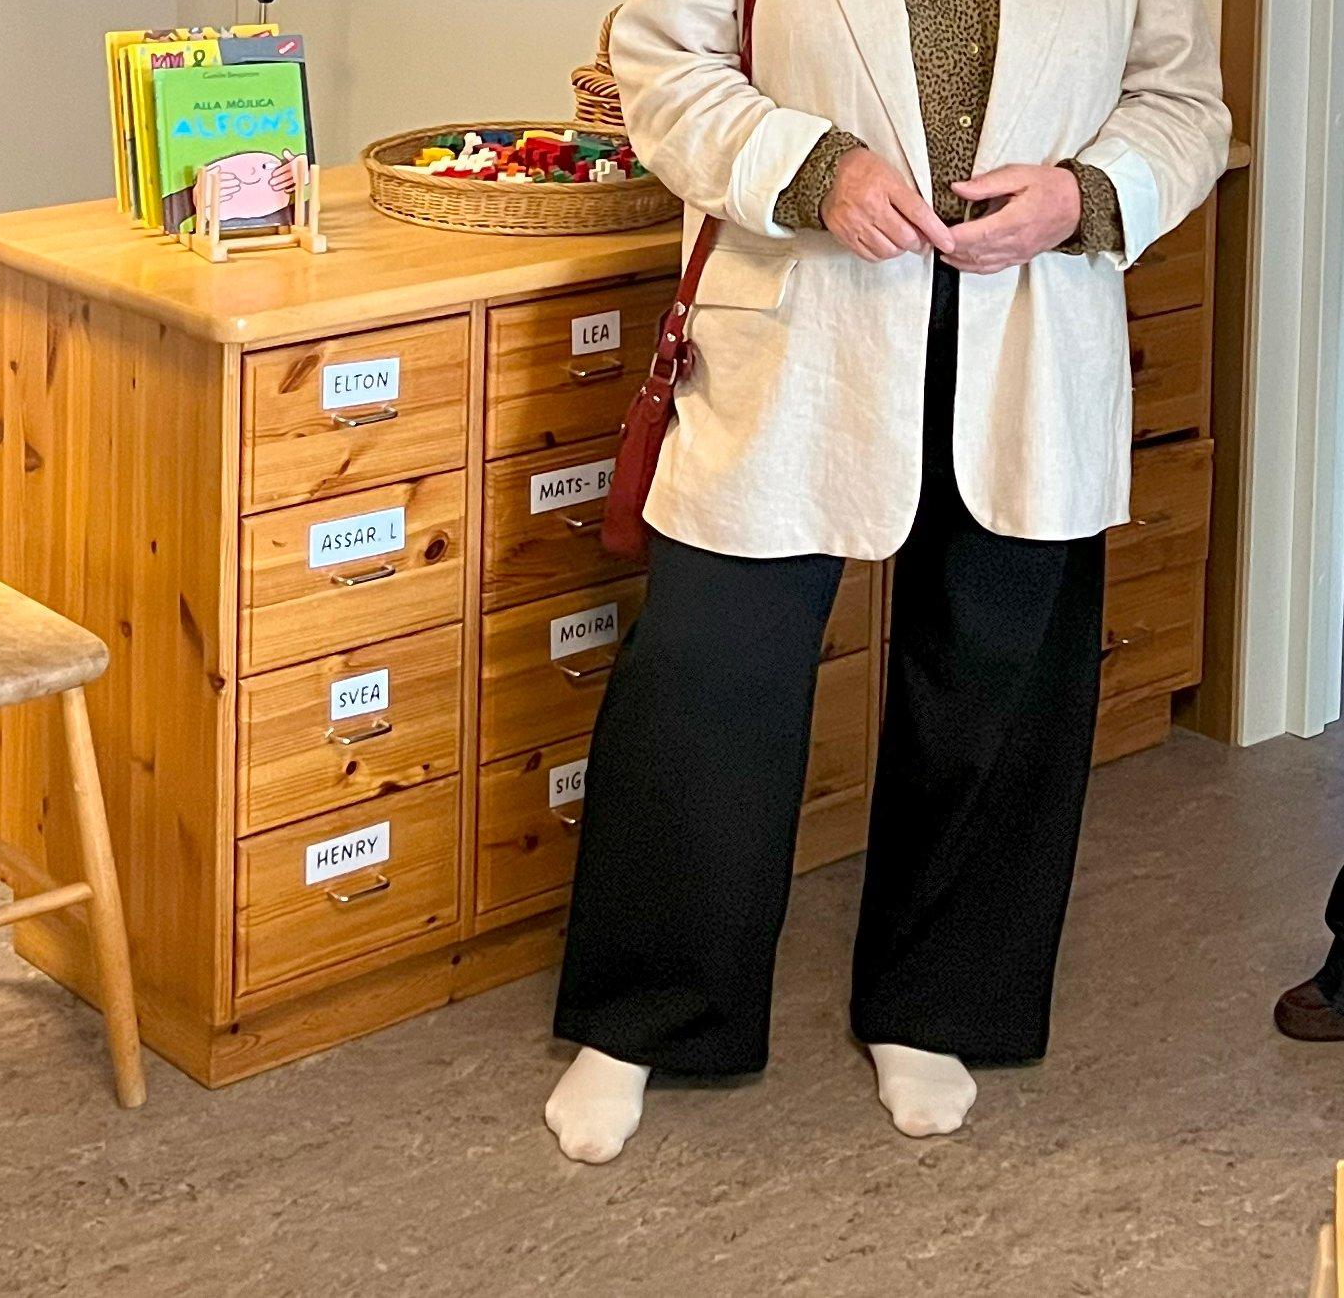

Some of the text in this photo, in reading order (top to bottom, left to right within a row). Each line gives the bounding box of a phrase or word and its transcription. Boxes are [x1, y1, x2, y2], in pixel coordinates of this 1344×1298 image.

[194, 100, 222, 111] ALLA
[172, 107, 301, 139] ALFONS
[582, 324, 610, 344] LEA
[334, 371, 389, 394] ELTON
[539, 477, 590, 501] MATS-
[390, 522, 397, 540] L
[560, 613, 615, 643] MOIRA
[339, 683, 380, 708] SVEA
[316, 835, 379, 869] HENRY
